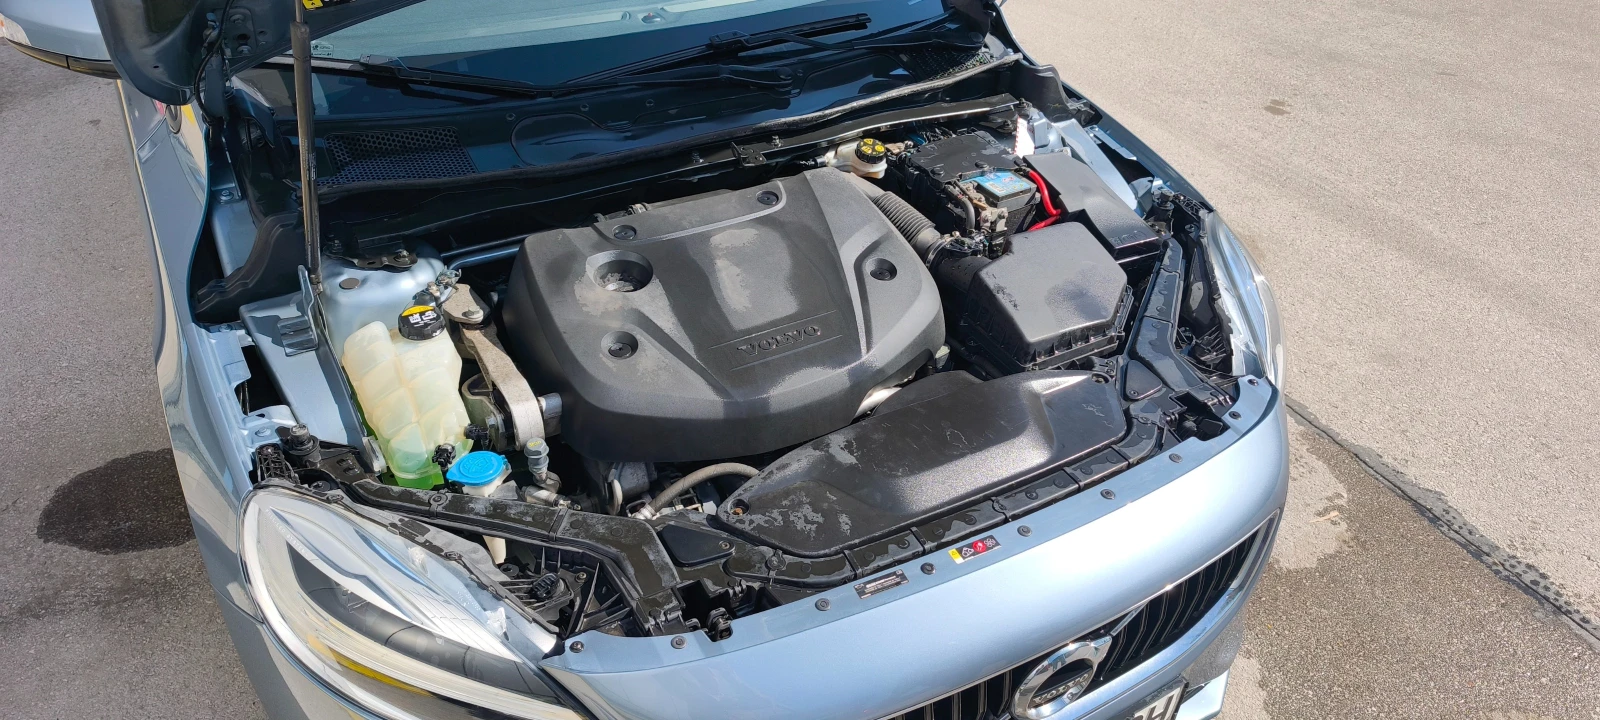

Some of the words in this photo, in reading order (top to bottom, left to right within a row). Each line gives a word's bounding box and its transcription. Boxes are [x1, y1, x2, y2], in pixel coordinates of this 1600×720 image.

[736, 325, 820, 356] VOLVO
[1032, 673, 1089, 704] VOLVO
[1131, 693, 1175, 720] H
